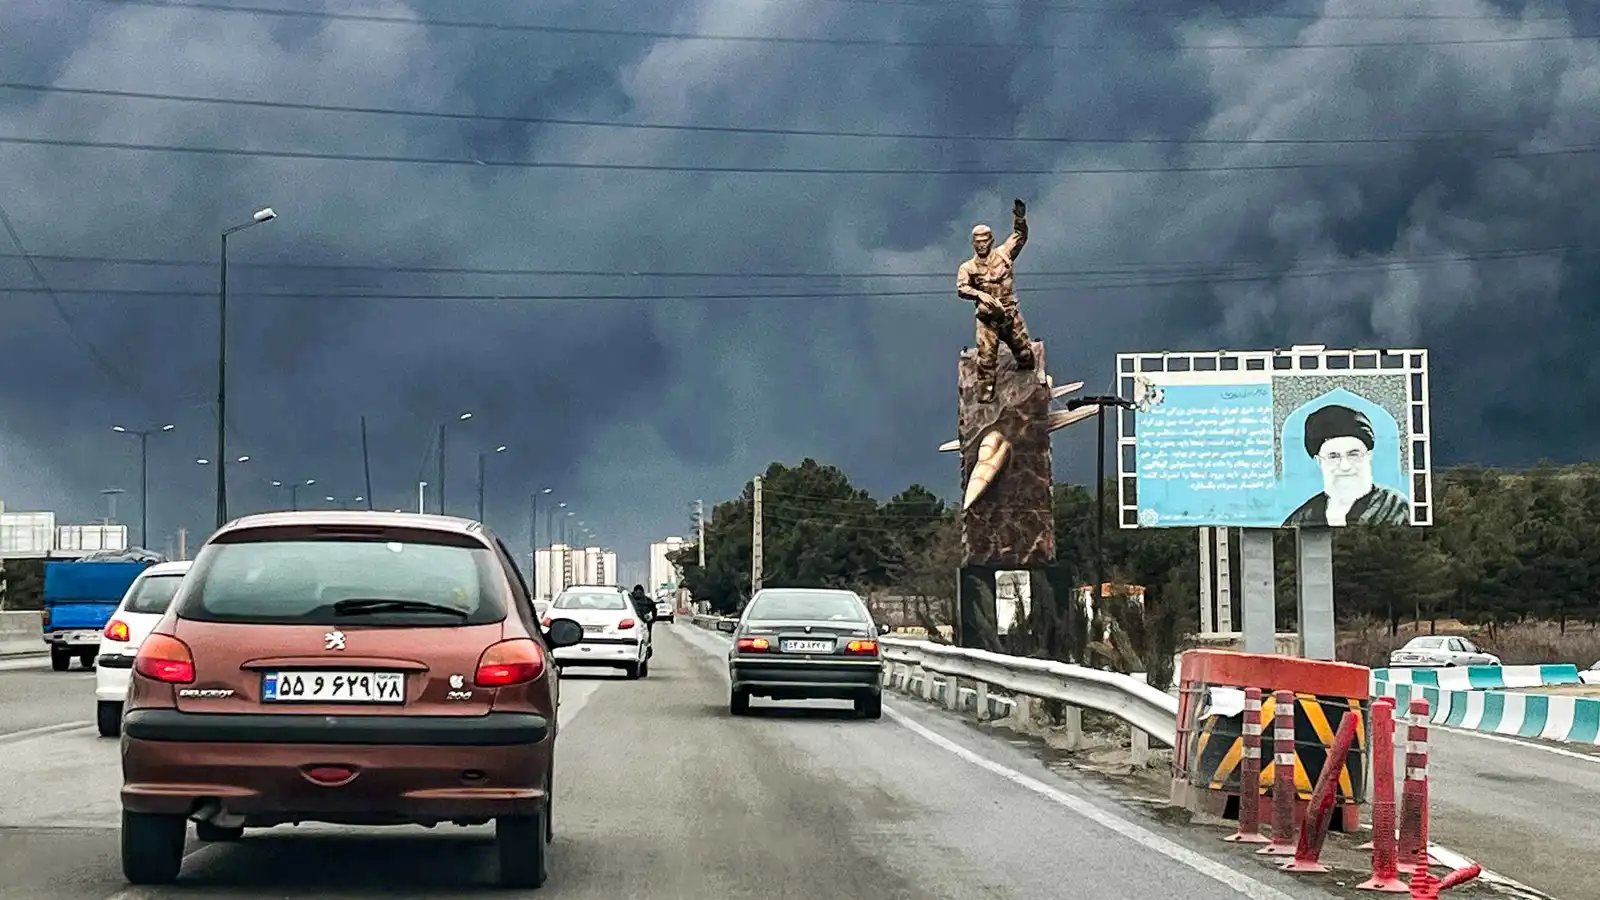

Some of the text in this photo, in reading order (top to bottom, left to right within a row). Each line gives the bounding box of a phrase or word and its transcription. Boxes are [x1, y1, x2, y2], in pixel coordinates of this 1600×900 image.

[280, 676, 304, 696] ۵۵
[313, 676, 324, 695] و
[332, 676, 371, 696] ۶۲۹
[376, 681, 400, 698] ۷۸
